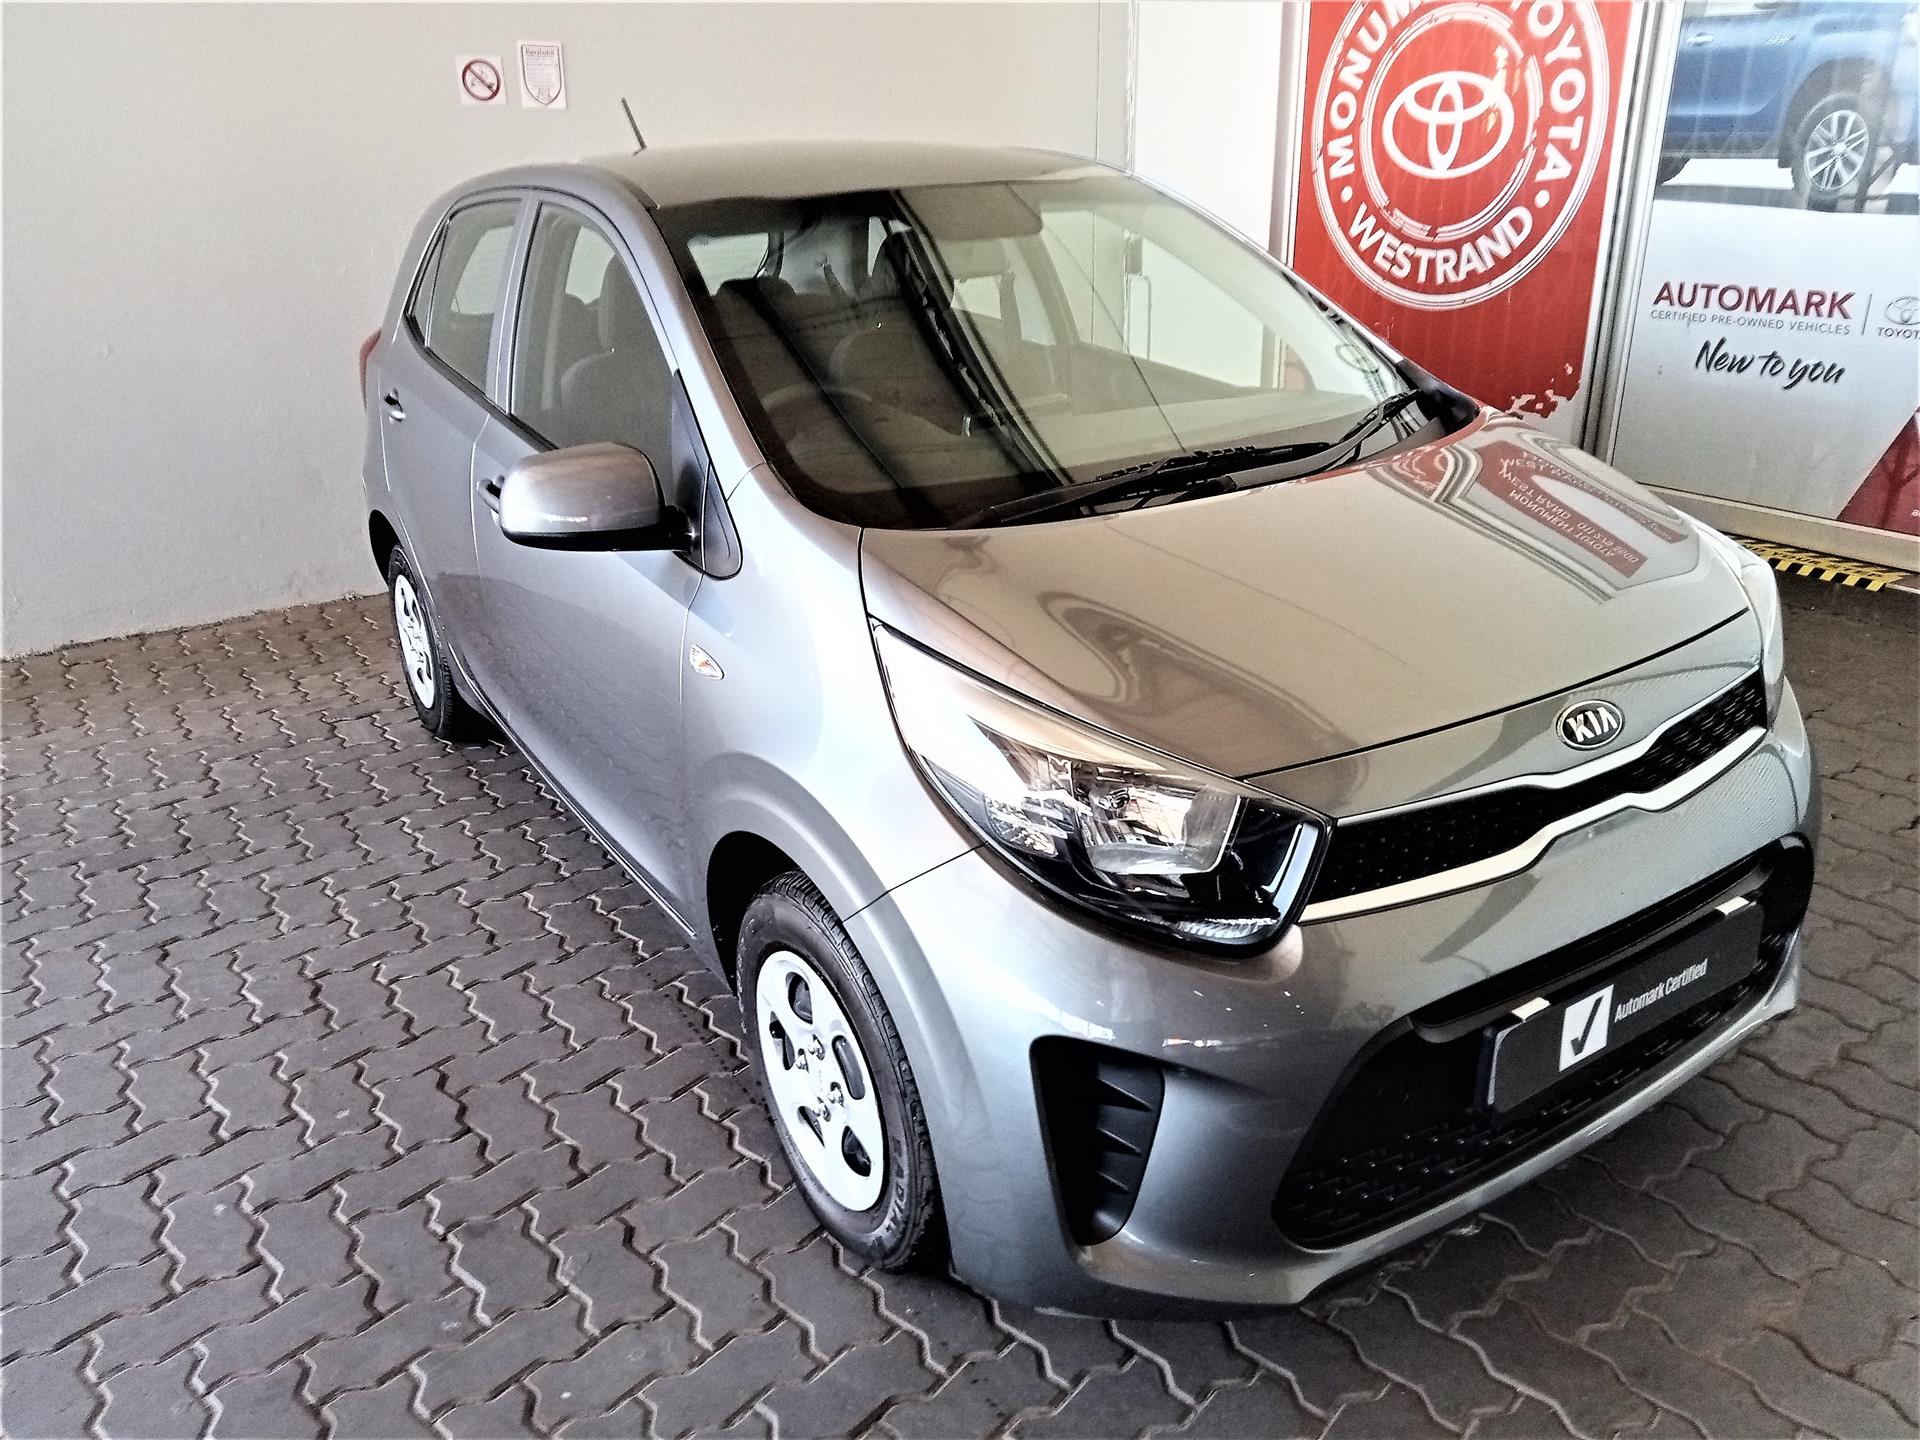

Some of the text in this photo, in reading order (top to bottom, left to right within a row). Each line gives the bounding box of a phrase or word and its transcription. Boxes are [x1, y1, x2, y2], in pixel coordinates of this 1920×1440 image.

[1349, 202, 1533, 285] WESTRAND
[1652, 281, 1856, 319] AUTOMARK
[1650, 309, 1851, 336] CERTIFIED PRE-OWNED VEHICLES
[1877, 326, 1920, 340] TOYOT
[1695, 336, 1846, 390] New to you
[1566, 706, 1618, 743] KIA
[1614, 957, 1708, 1023] Automark Certified
